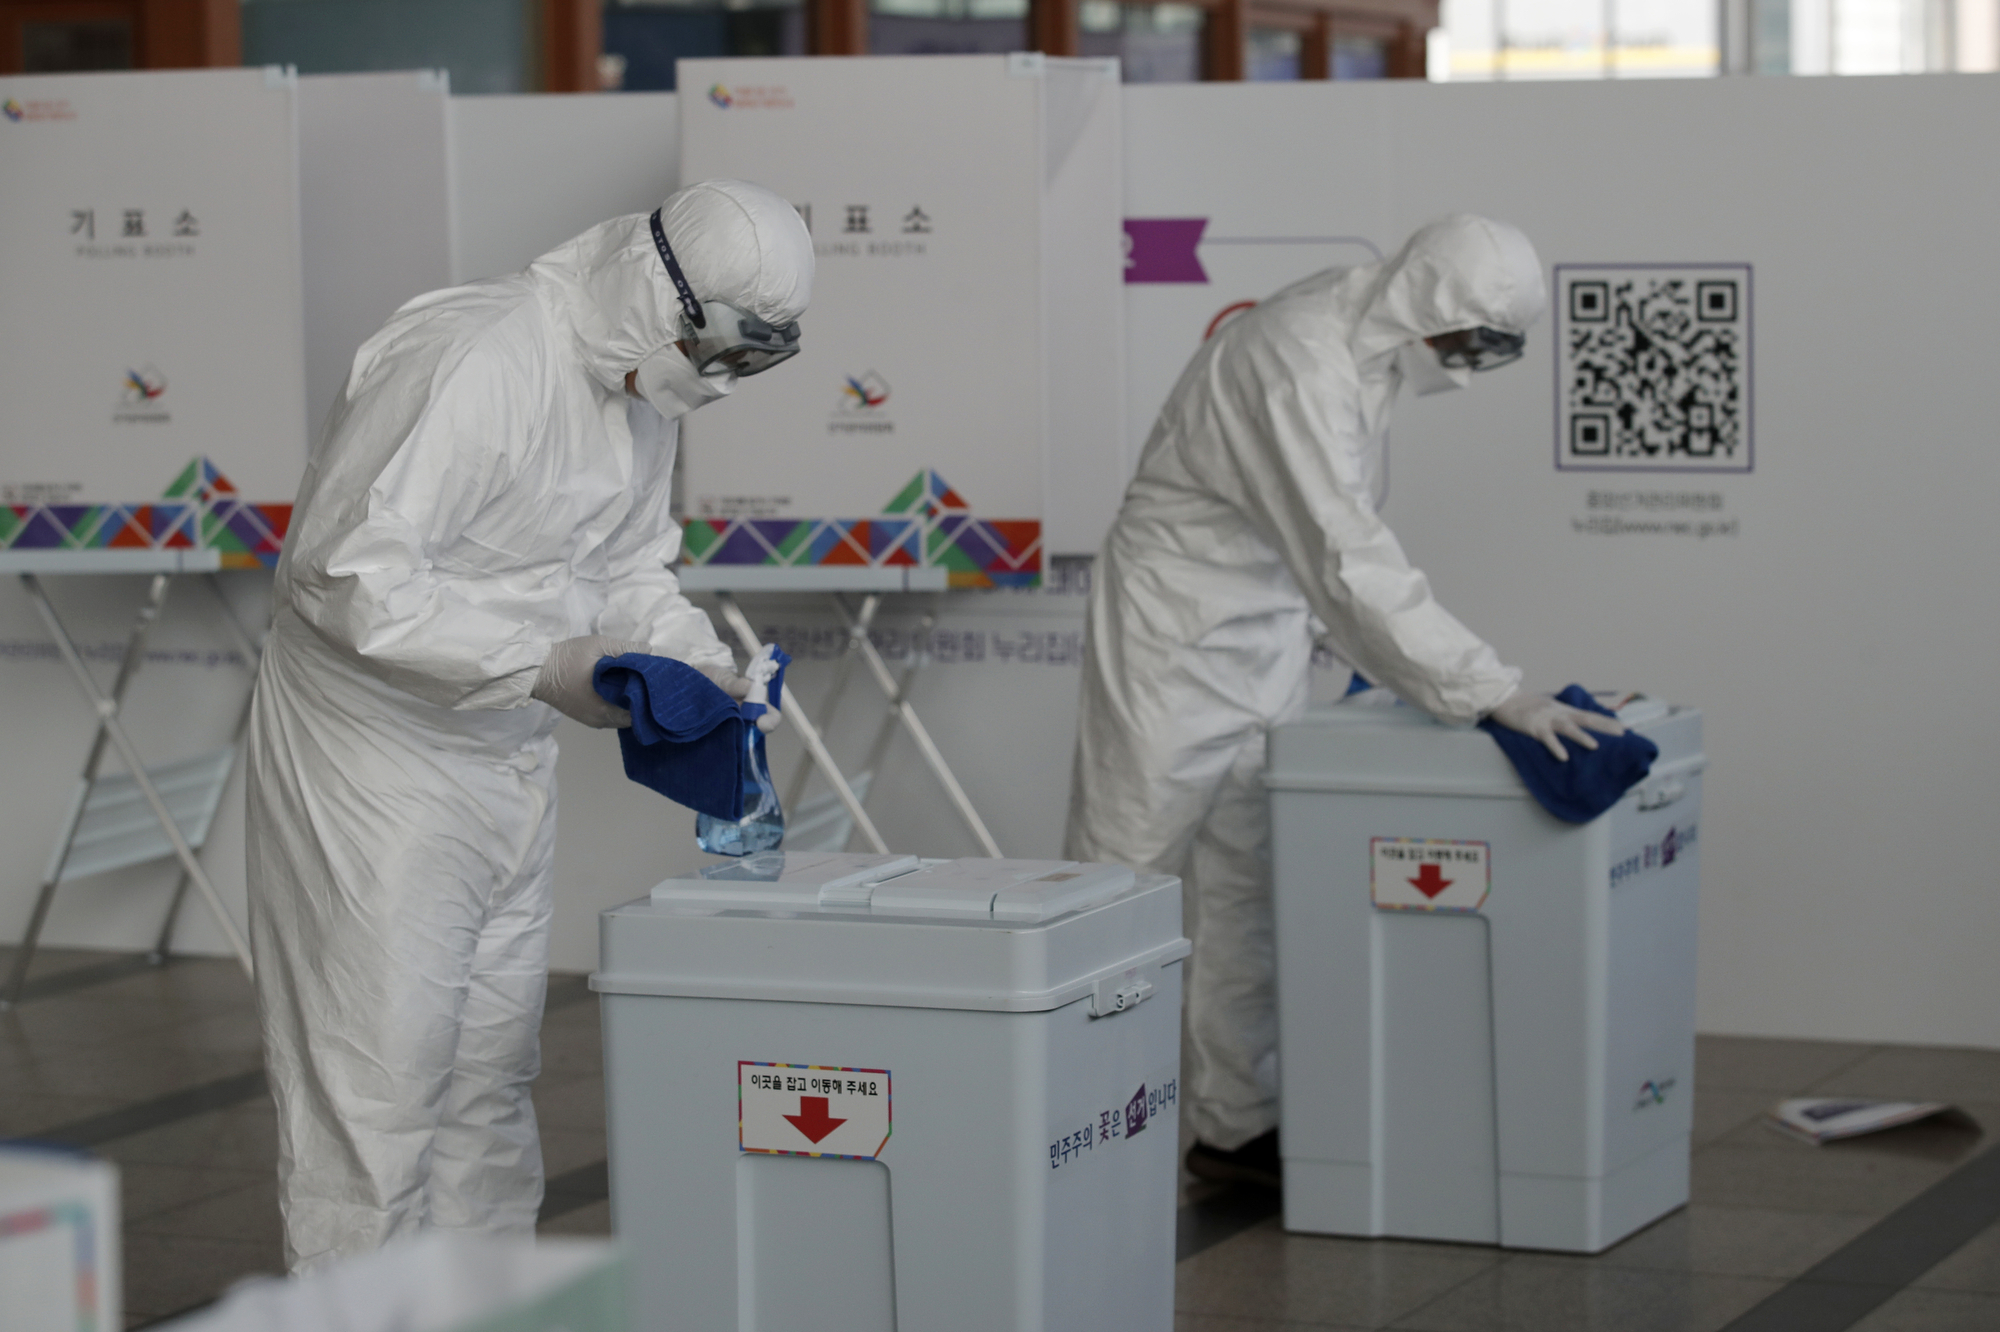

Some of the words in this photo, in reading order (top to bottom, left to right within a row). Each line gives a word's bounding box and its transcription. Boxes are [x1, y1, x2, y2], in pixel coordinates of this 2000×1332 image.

[654, 230, 671, 261] OTOS
[751, 1074, 782, 1091] 이곳을
[786, 1076, 807, 1092] 잡고
[811, 1078, 842, 1094] 이동해
[846, 1080, 878, 1096] 주세요
[1050, 1123, 1093, 1169] 민주주의
[1098, 1109, 1122, 1145] 꽃은
